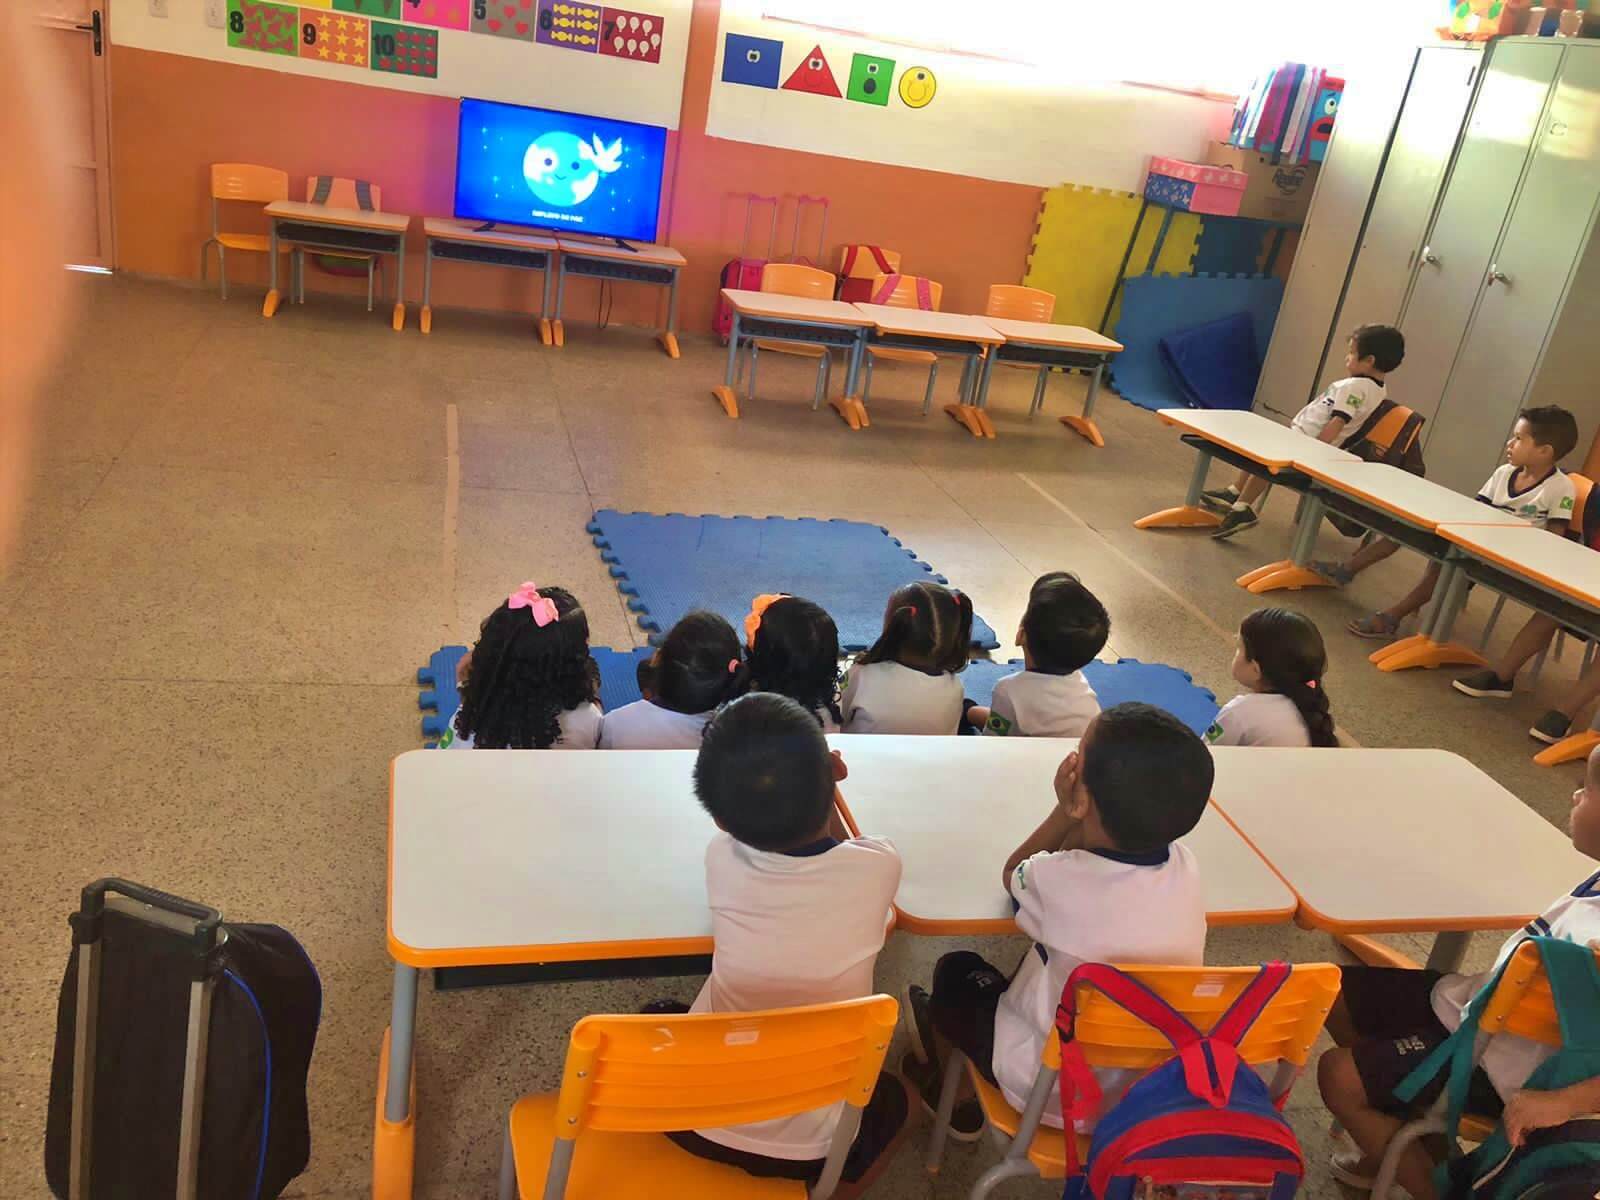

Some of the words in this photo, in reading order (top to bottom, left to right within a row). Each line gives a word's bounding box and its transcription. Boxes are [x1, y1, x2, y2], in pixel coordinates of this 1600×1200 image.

[474, 0, 486, 19] 5
[540, 9, 551, 30] 6
[230, 11, 244, 33] 8
[603, 20, 615, 41] 7
[302, 23, 316, 45] 9
[373, 34, 395, 56] 10
